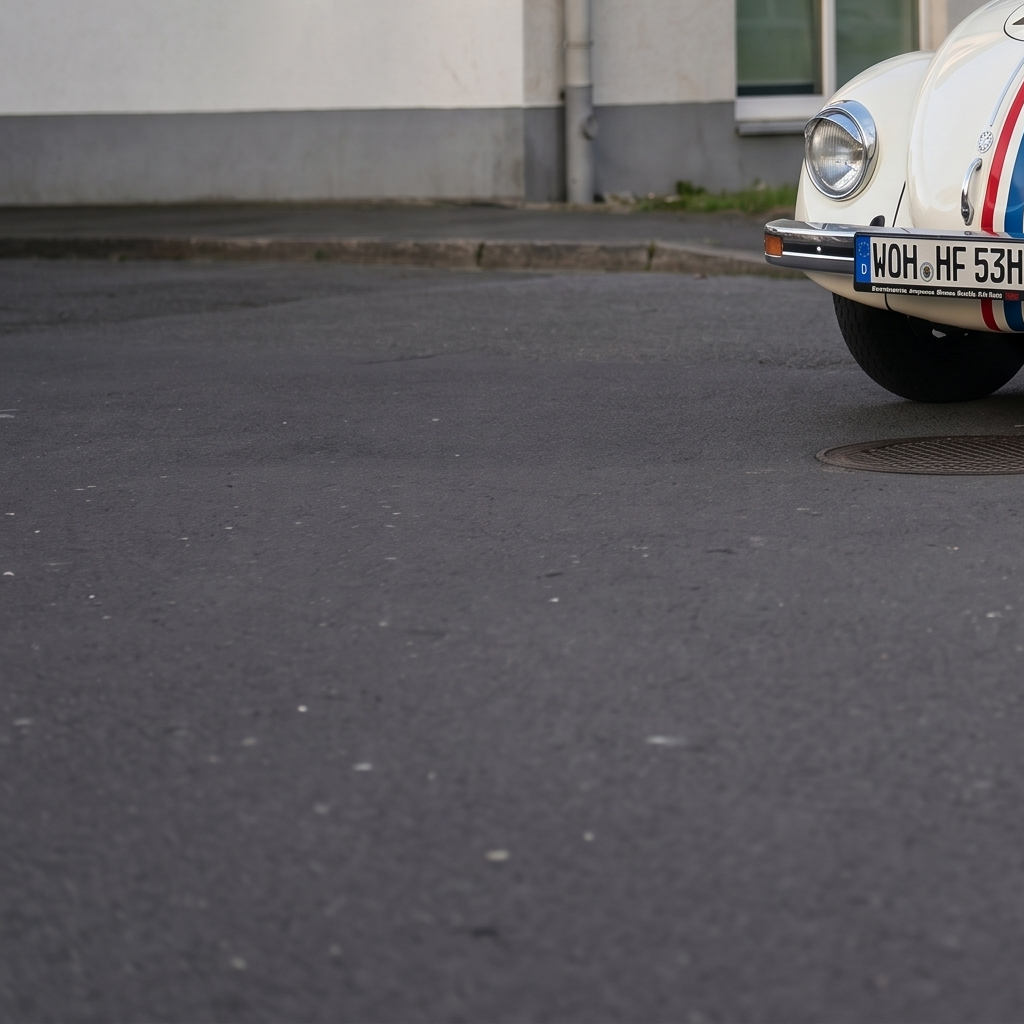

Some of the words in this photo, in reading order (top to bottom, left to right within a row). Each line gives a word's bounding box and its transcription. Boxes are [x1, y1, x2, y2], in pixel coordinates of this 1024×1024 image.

[860, 263, 868, 275] D
[872, 242, 918, 280] WOH
[936, 245, 967, 282] HF
[974, 247, 1023, 285] 53H
